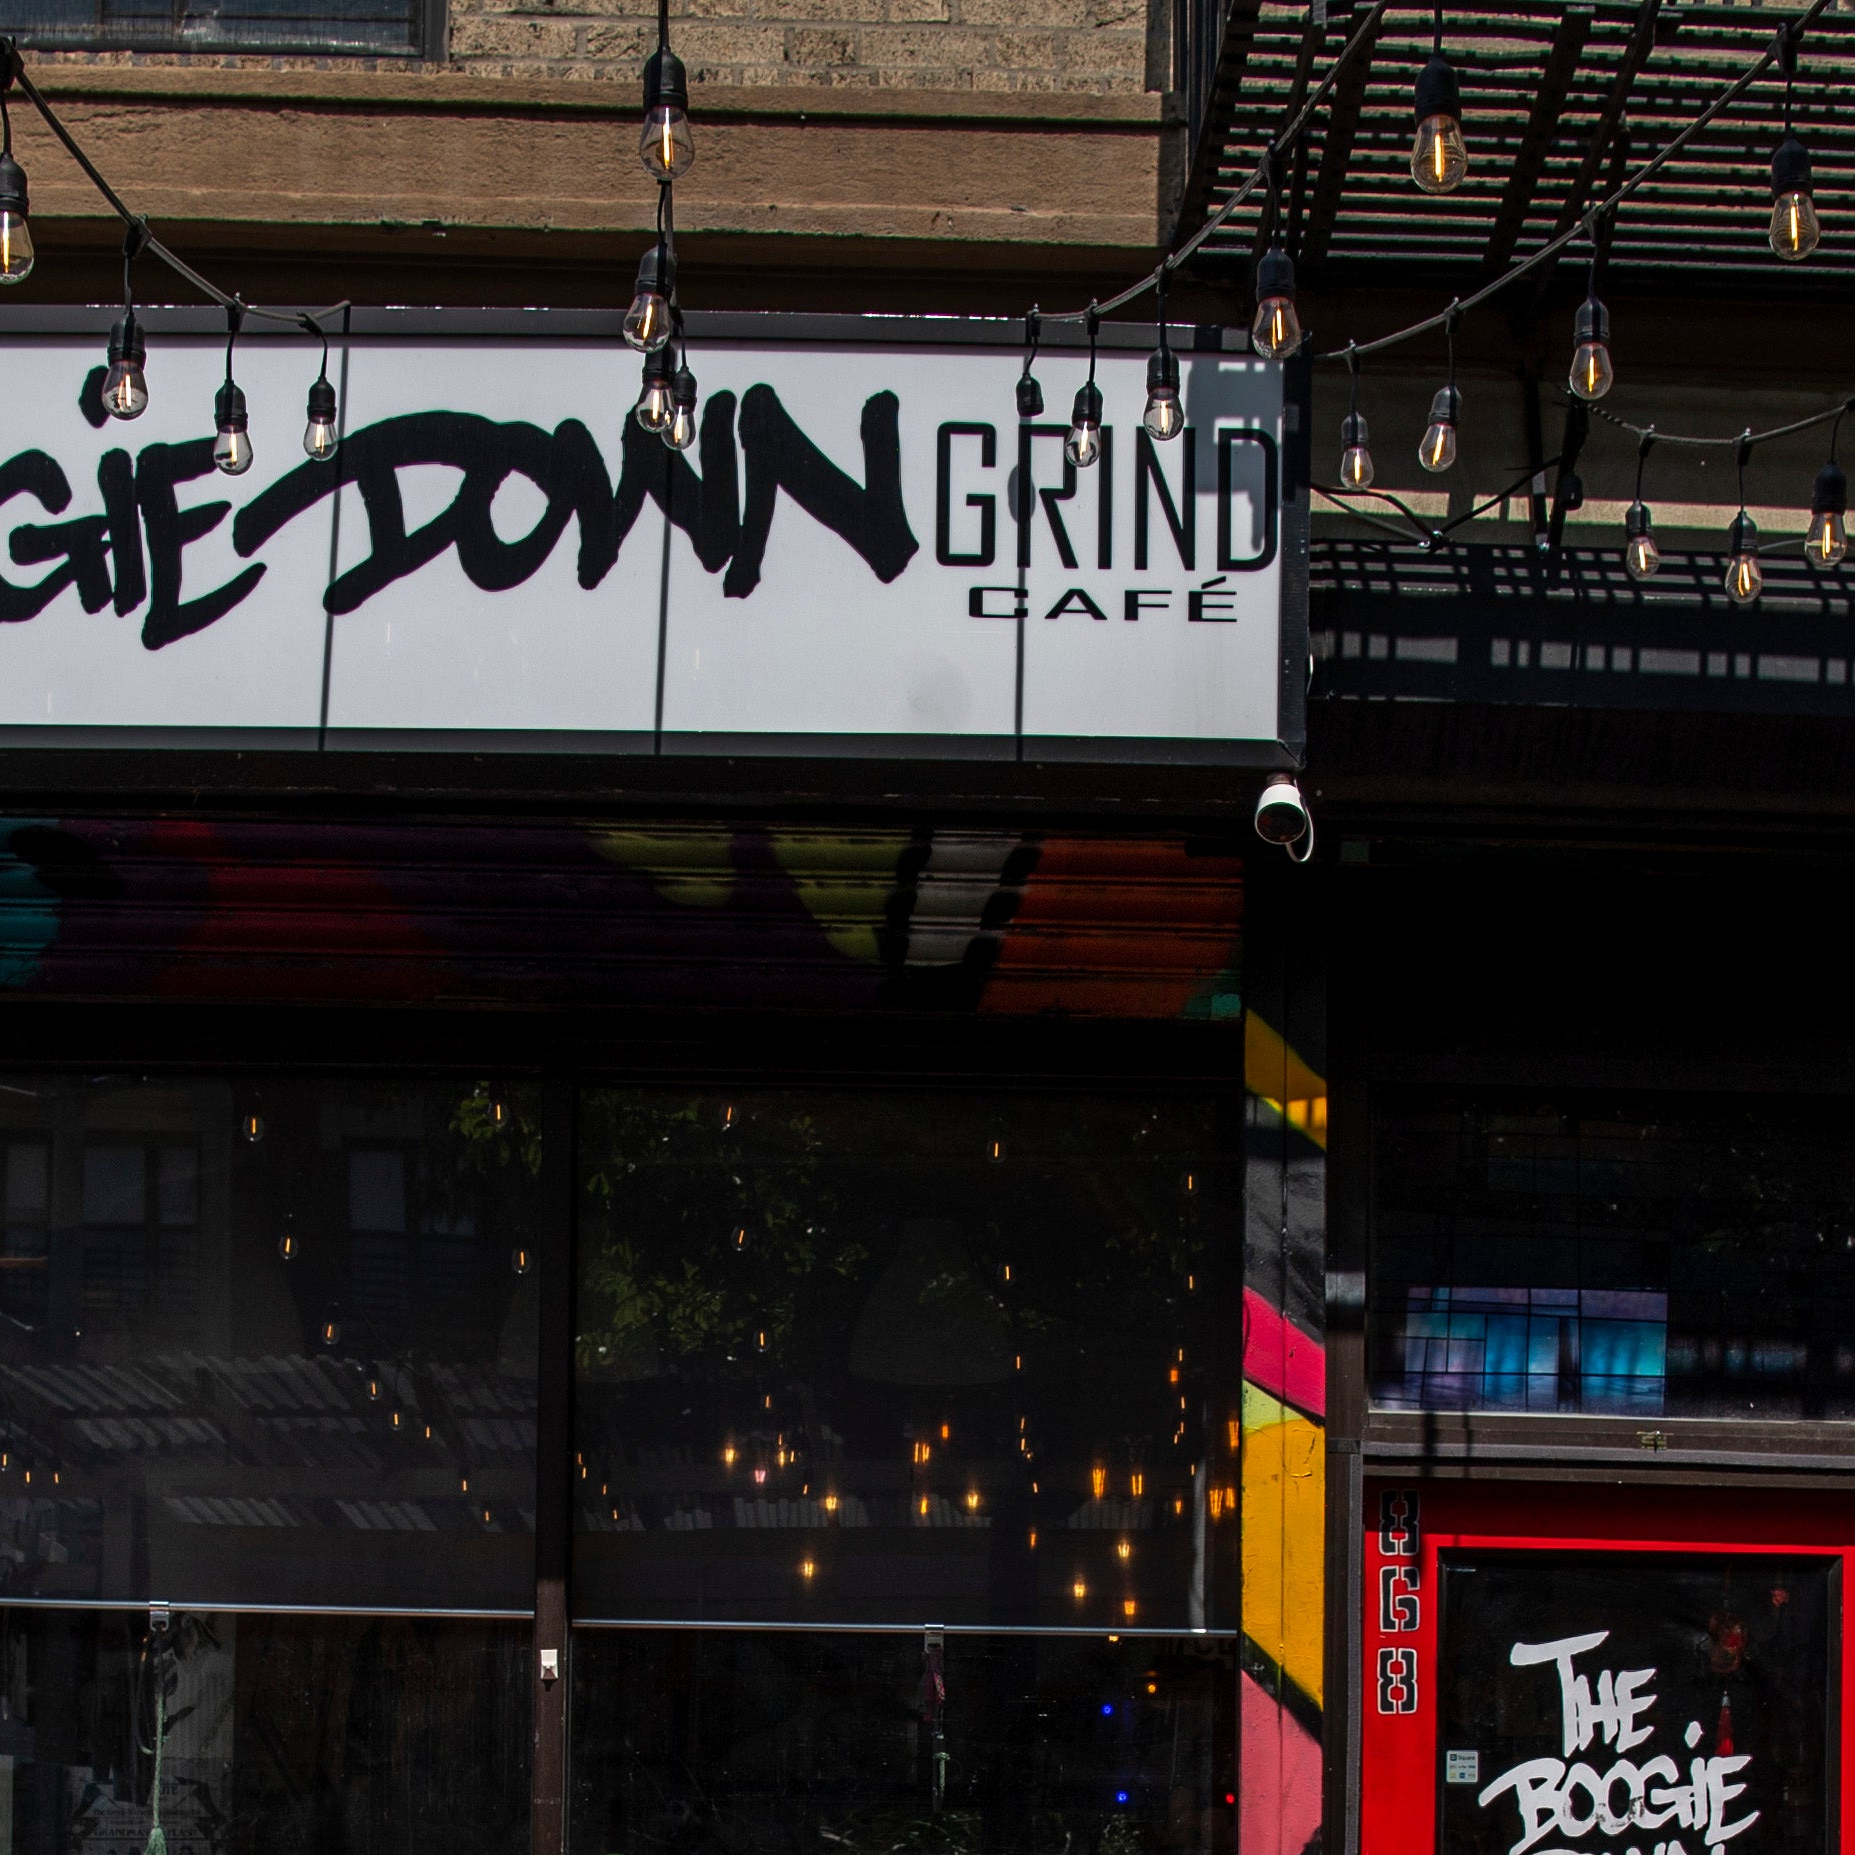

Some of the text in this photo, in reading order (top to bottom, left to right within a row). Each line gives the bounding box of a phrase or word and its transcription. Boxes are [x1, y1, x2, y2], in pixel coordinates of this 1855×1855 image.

[233, 382, 919, 617] DOWN
[936, 422, 1278, 571] GRIND
[969, 576, 1237, 622] CAFÉ
[1509, 1631, 1656, 1757] THE
